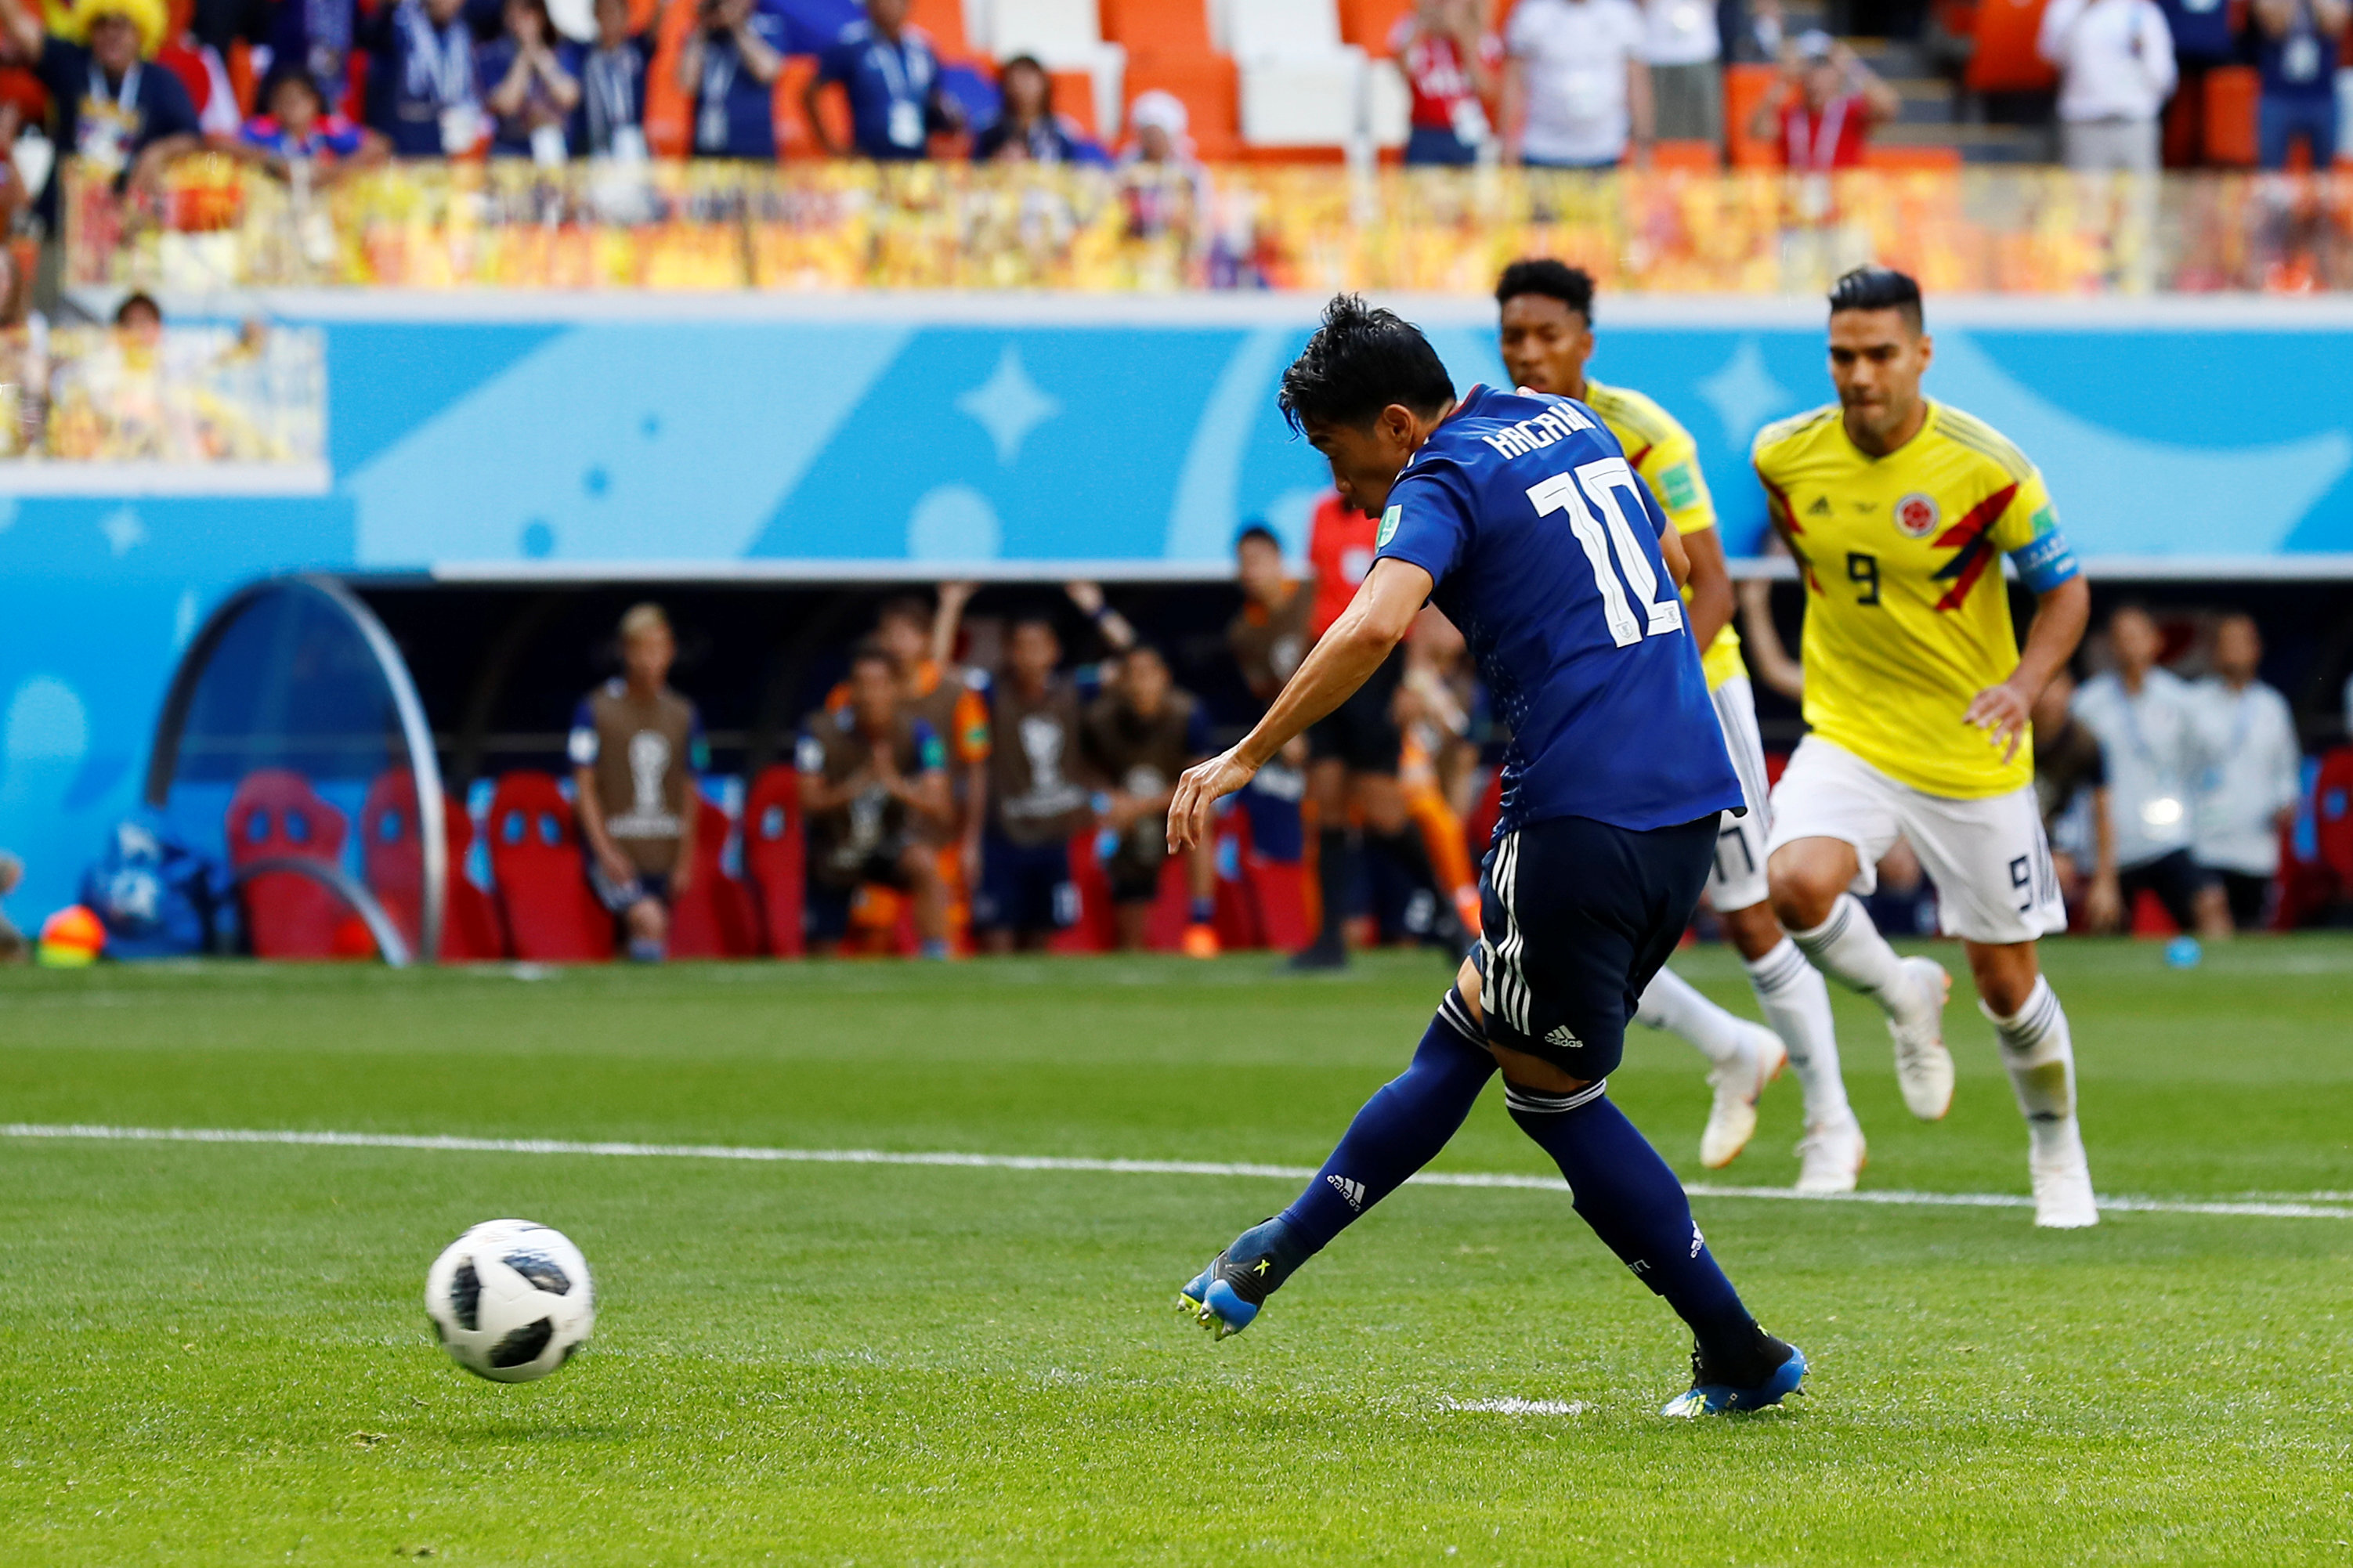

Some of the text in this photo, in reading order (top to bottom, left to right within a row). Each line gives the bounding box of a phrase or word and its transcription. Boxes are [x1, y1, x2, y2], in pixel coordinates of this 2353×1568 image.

[1524, 456, 1686, 649] 10
[1846, 552, 1881, 605] 9
[2008, 854, 2033, 914] 9
[1544, 1035, 1584, 1048] adidas
[1326, 1174, 1361, 1212] adidas
